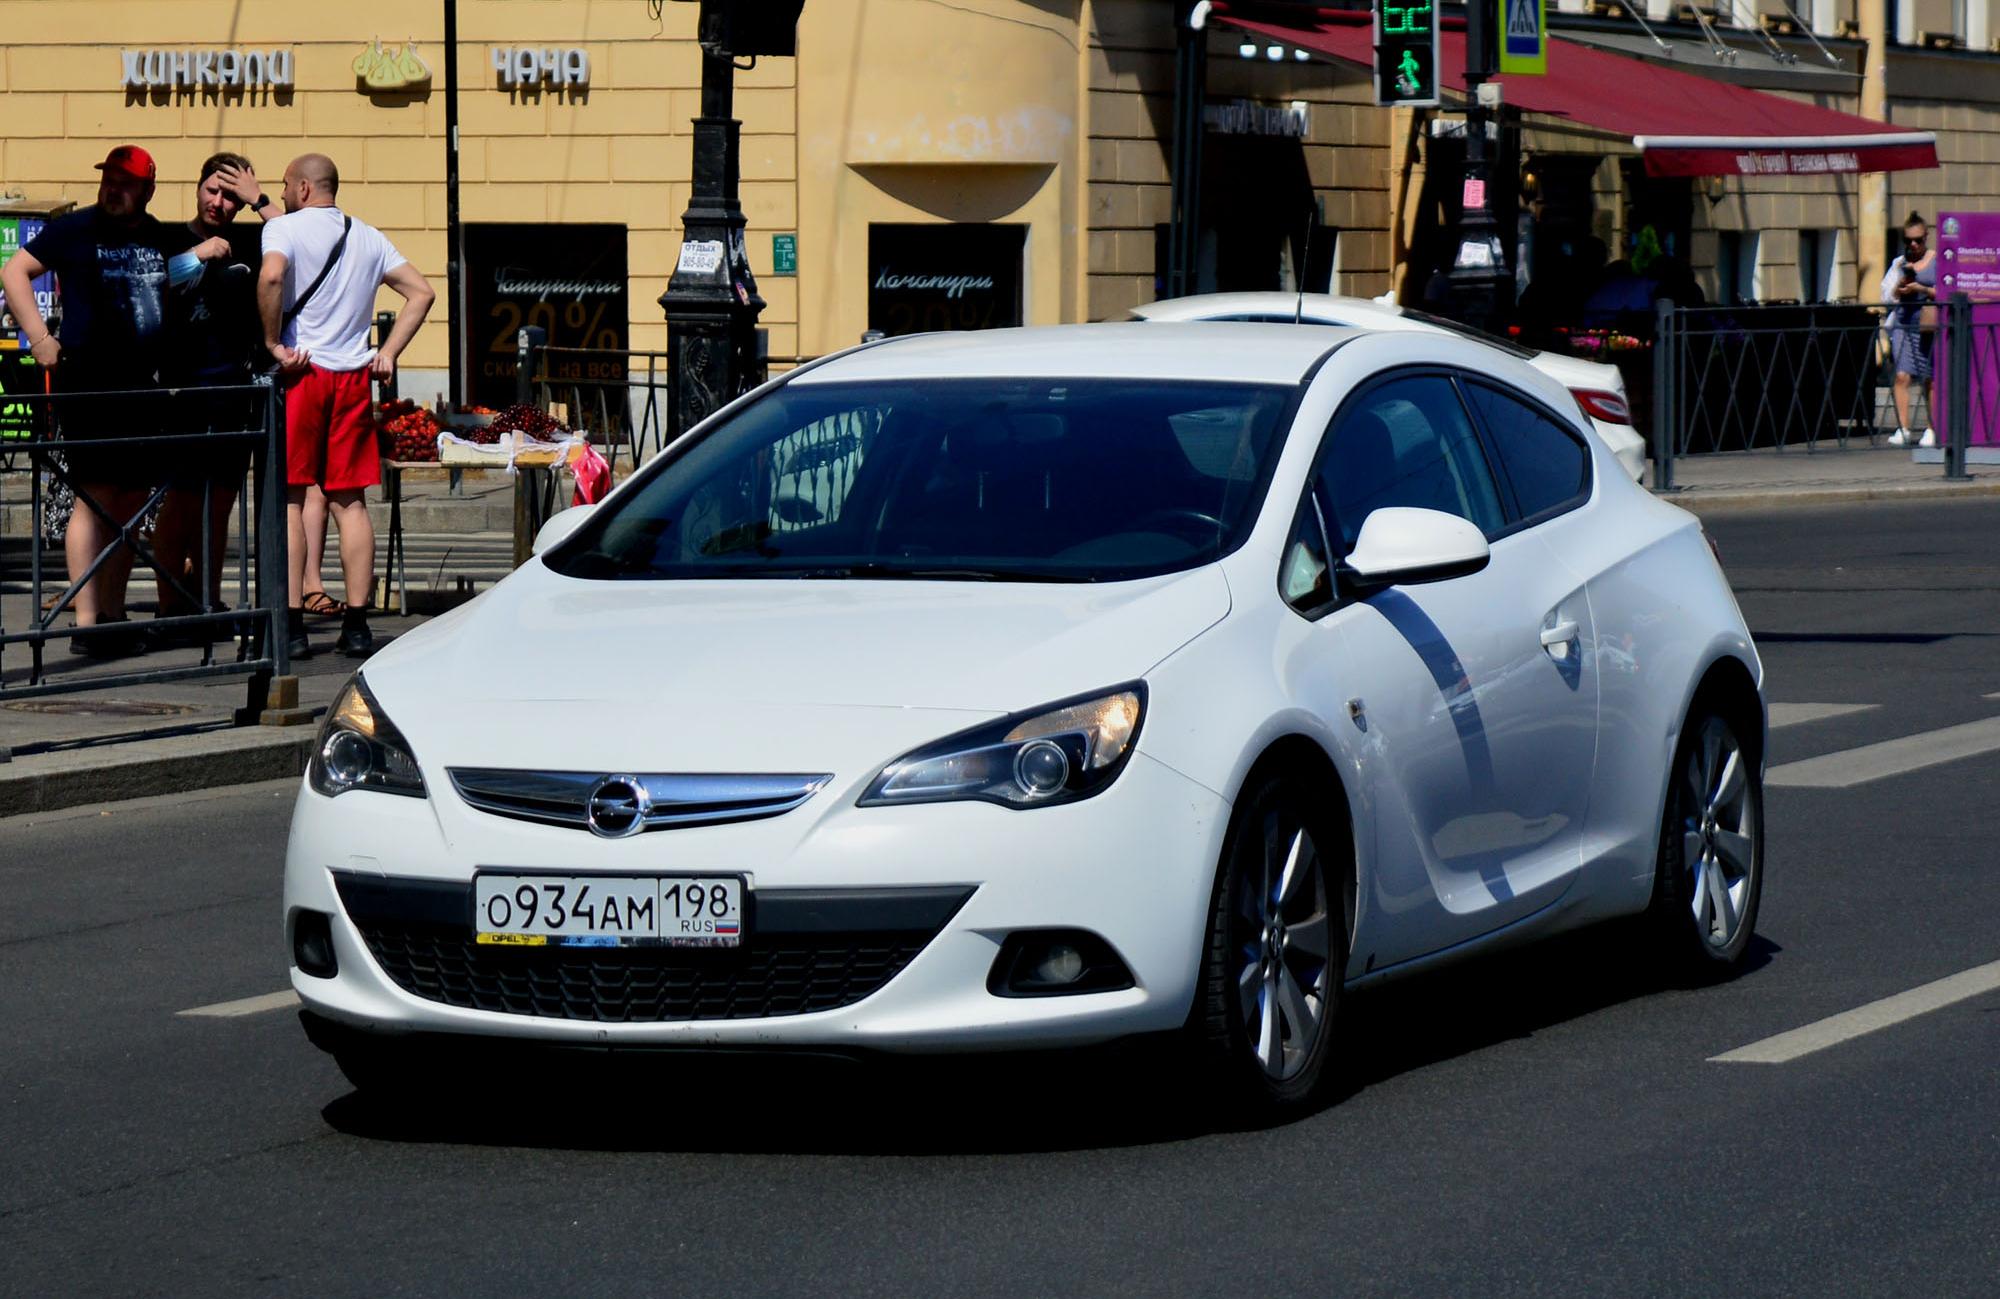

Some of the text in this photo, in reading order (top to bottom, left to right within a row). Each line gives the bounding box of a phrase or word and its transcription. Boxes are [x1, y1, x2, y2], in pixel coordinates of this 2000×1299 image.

[121, 49, 294, 86] ХИНКАЛИ
[491, 48, 590, 84] ЧАЧА
[3, 227, 16, 243] 11
[97, 247, 129, 260] NEW
[685, 243, 716, 253] ОТДЫХ
[875, 265, 994, 299] Хачапури
[488, 301, 620, 353] 20%
[560, 362, 582, 378] на
[588, 361, 623, 378] все
[664, 883, 729, 918] 198
[680, 919, 714, 933] RUS
[491, 935, 519, 943] OPEL
